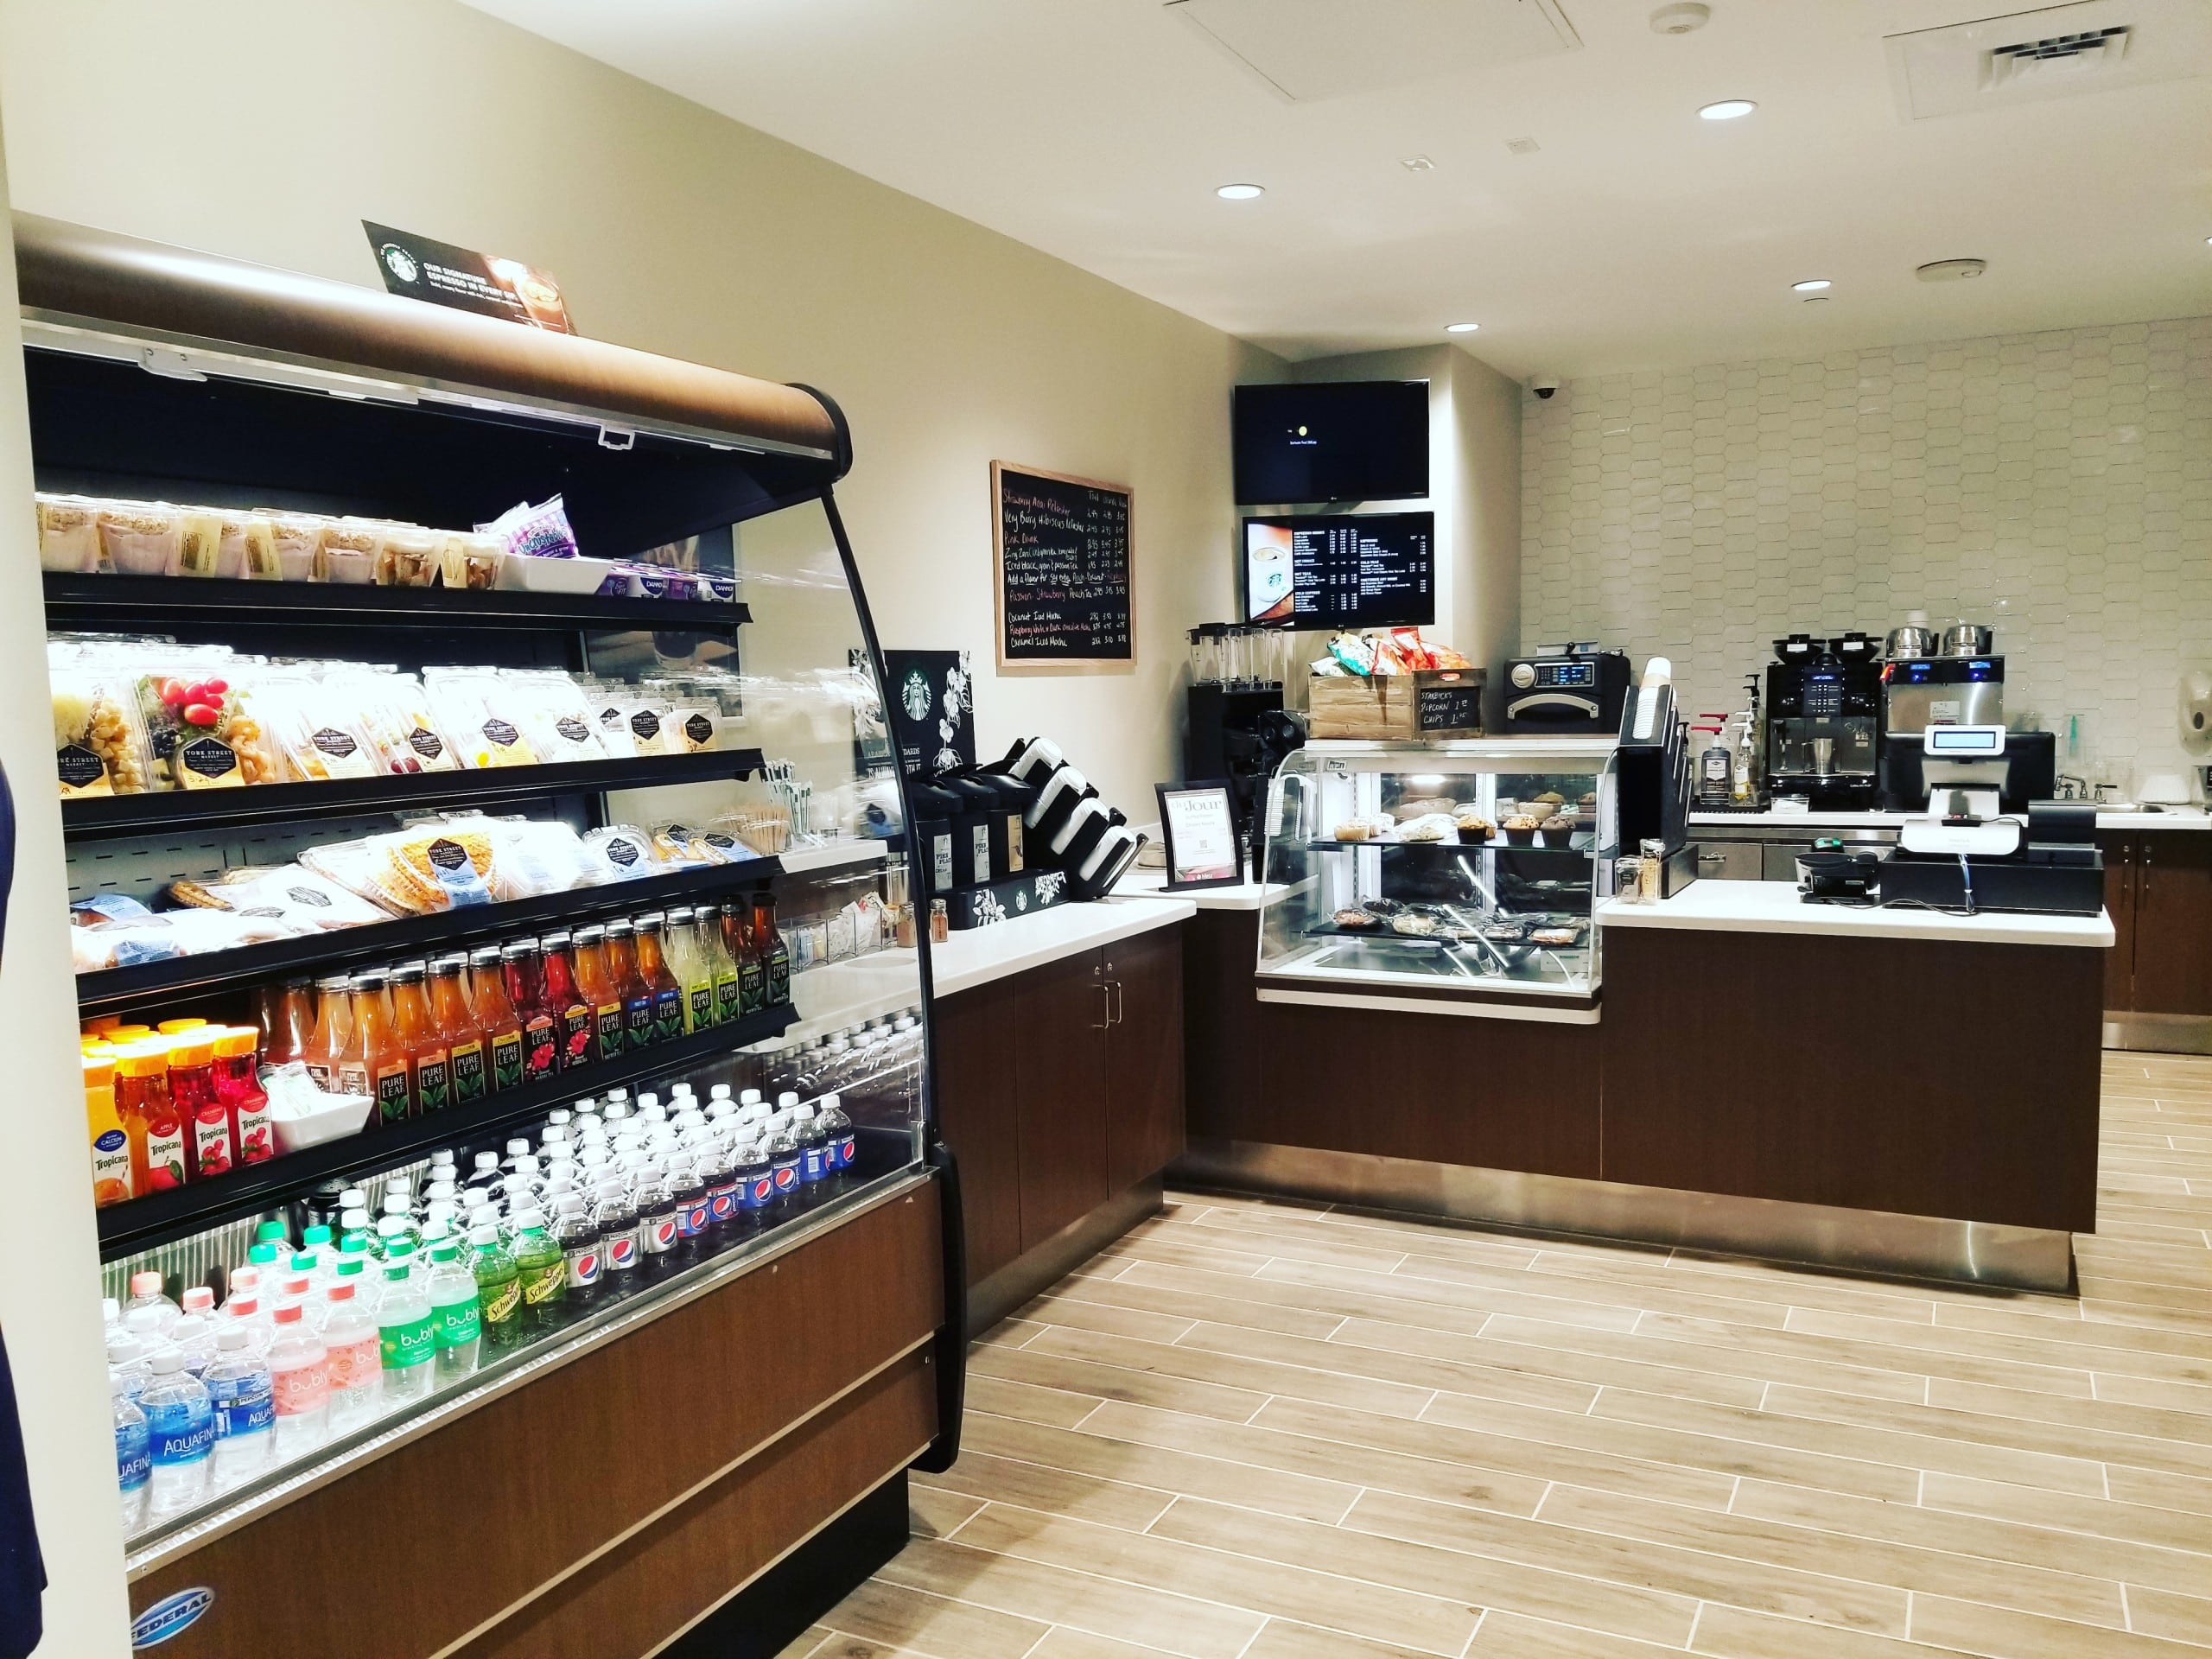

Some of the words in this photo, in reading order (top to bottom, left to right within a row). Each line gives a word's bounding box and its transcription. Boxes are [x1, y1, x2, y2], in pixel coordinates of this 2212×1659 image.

[1007, 573, 1018, 584] Add
[1185, 800, 1222, 811] Jour
[773, 963, 787, 972] PURE
[745, 973, 760, 982] PURE
[774, 970, 787, 979] LEAF
[720, 983, 736, 994] PURE
[745, 981, 760, 990] LEAF
[693, 991, 709, 1001] PURE
[721, 991, 736, 1001] LEAF
[659, 1001, 677, 1010] PURE
[693, 999, 709, 1009] LEAF
[632, 1008, 650, 1020] PURE
[659, 1007, 678, 1018] LEAF
[601, 1014, 620, 1025] PURE
[632, 1016, 651, 1027] LEAF
[570, 1022, 586, 1032] LEAF
[601, 1020, 620, 1033] LEAF
[531, 1028, 550, 1037] PURE
[532, 1036, 550, 1046] LEAF
[498, 1045, 518, 1057] PURE
[457, 1055, 480, 1067] PURE
[498, 1053, 519, 1065] LEAF
[422, 1065, 443, 1078] PURE
[458, 1063, 480, 1076] LEAF
[382, 1076, 404, 1089] PURE
[423, 1074, 445, 1086] LEAF
[382, 1084, 405, 1098] LEAF
[199, 1127, 227, 1142] Tropicana
[151, 1141, 181, 1156] Tropicana
[95, 1155, 129, 1171] Tropicana
[356, 1344, 379, 1364] bub
[248, 1404, 276, 1426] AQUAF
